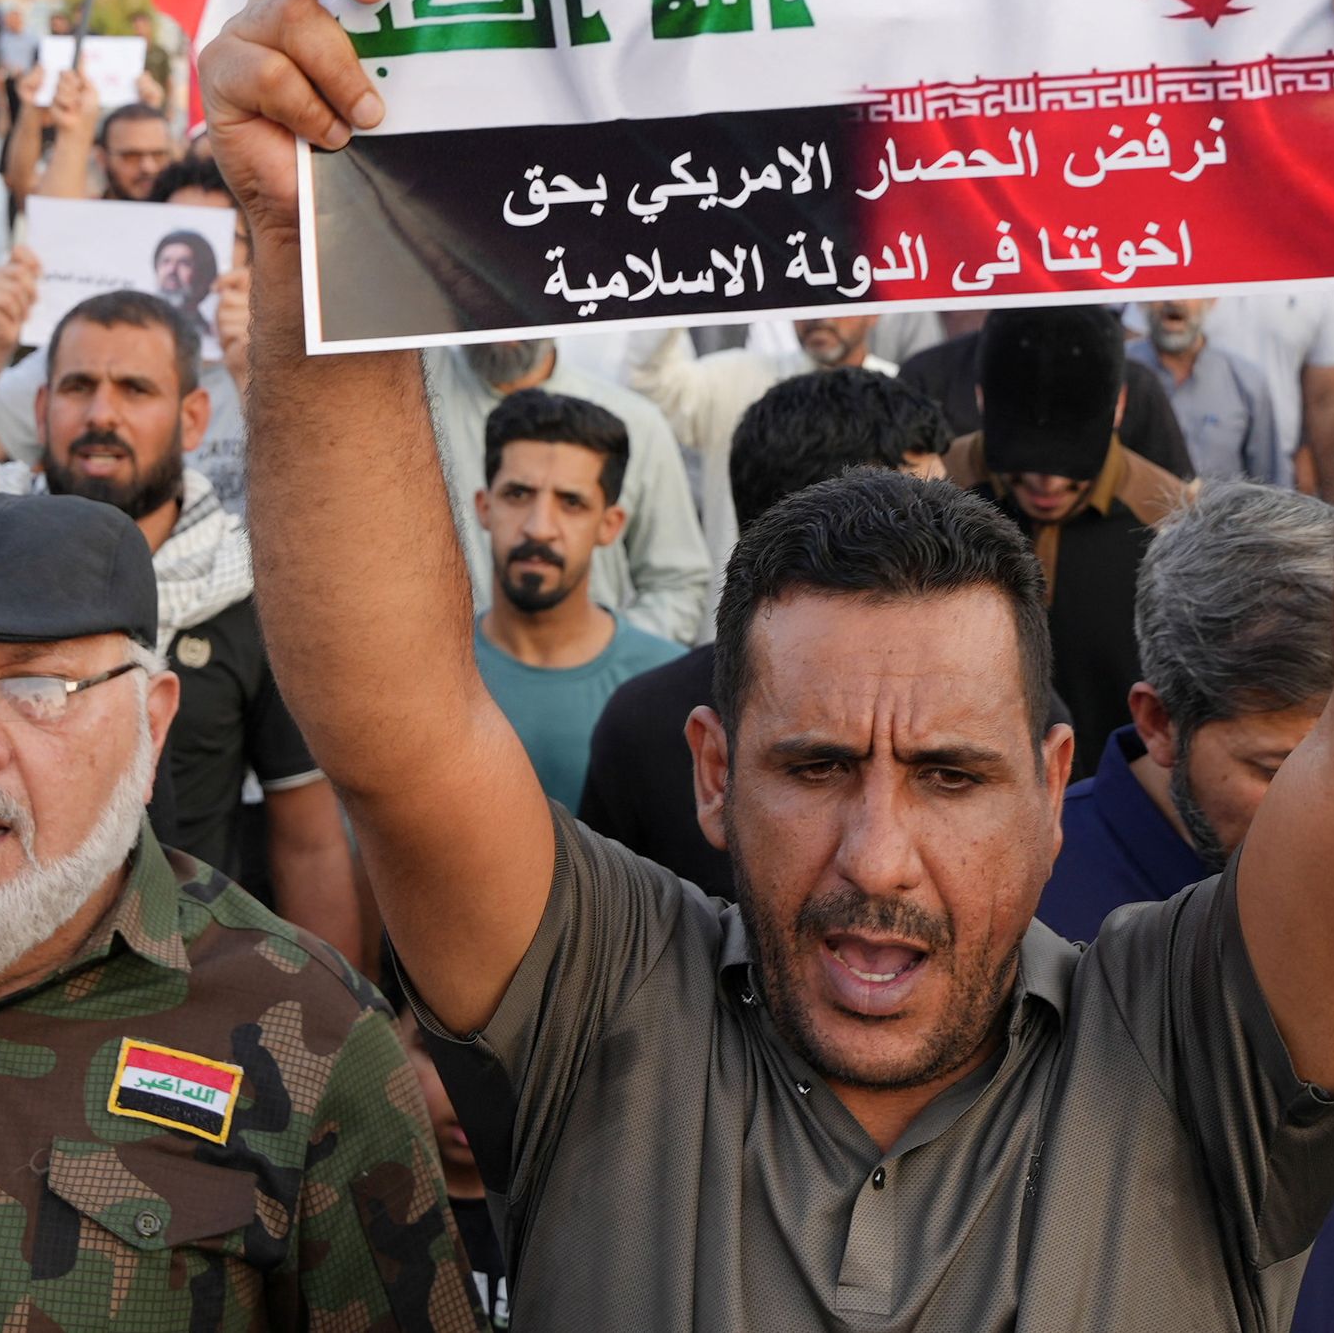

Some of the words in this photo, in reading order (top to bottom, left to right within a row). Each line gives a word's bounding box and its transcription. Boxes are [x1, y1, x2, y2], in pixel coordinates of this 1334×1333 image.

[626, 140, 833, 225] الامريكي
[854, 126, 1039, 201] الحصار
[1063, 111, 1228, 188] نرفض
[502, 163, 609, 227] بحق
[543, 243, 766, 317] الاسلامية
[784, 229, 930, 299] الدولة
[1037, 218, 1193, 284] اخوتنا
